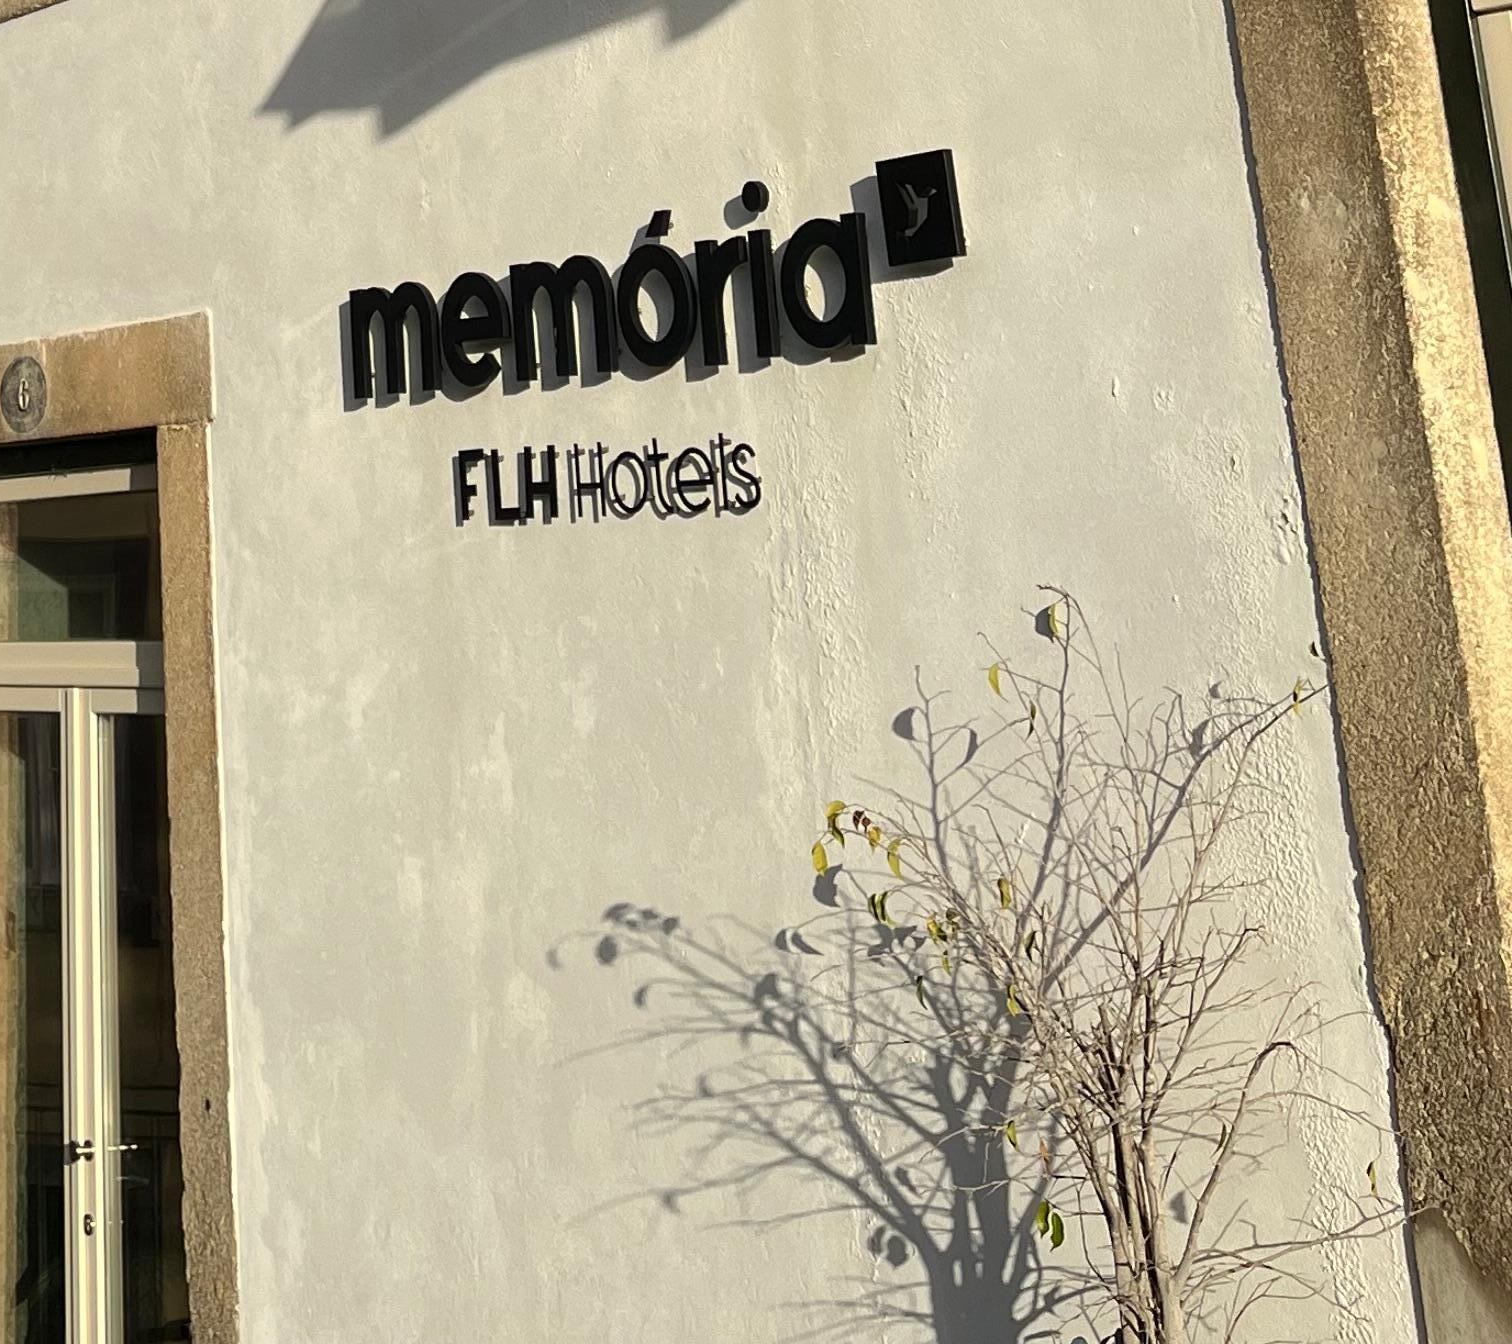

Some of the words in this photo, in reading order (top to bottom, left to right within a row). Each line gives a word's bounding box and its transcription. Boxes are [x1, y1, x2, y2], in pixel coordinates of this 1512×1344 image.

[348, 180, 877, 400] memória
[18, 377, 30, 411] 6
[457, 444, 559, 521] FLH
[573, 432, 762, 518] Hotels
